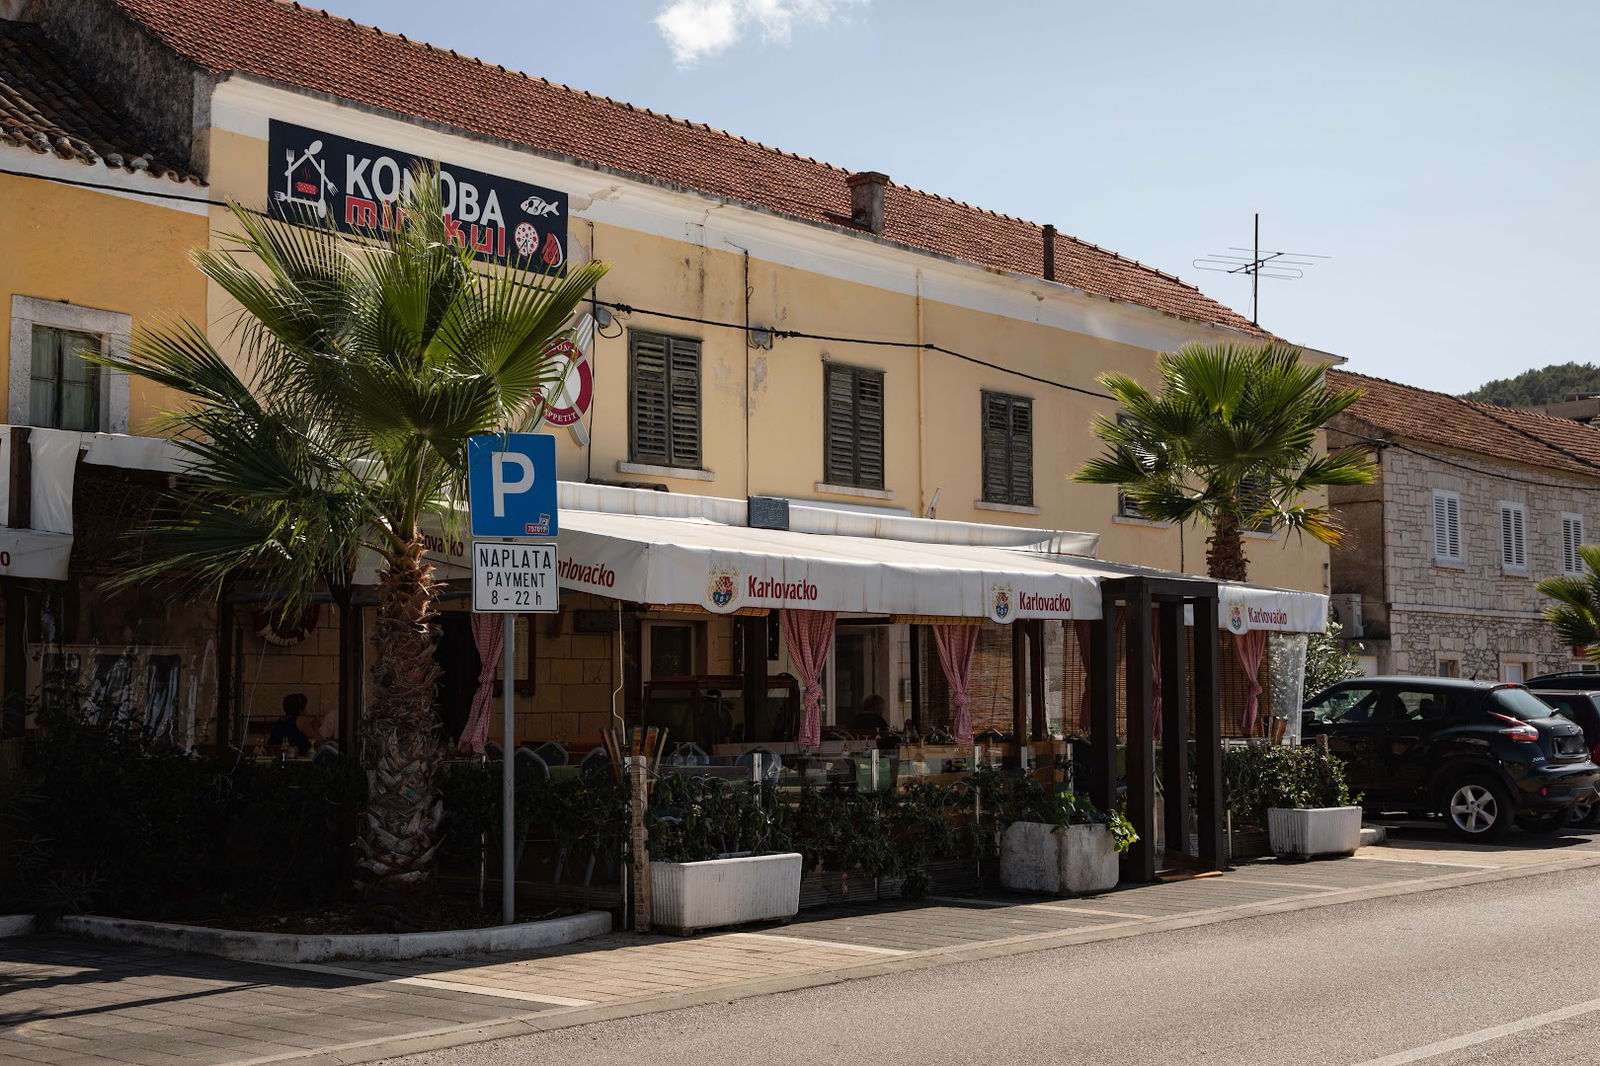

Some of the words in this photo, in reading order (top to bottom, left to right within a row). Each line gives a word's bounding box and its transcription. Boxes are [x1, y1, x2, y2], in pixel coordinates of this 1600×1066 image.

[345, 195, 505, 257] mirkul
[491, 451, 535, 517] P
[480, 548, 551, 569] NAPLATA
[487, 571, 545, 588] PAYMENT
[558, 557, 615, 587] rlovačko
[748, 575, 817, 600] Karlovačko
[1019, 591, 1071, 612] Karlovačko
[1247, 607, 1287, 624] Karlovačko
